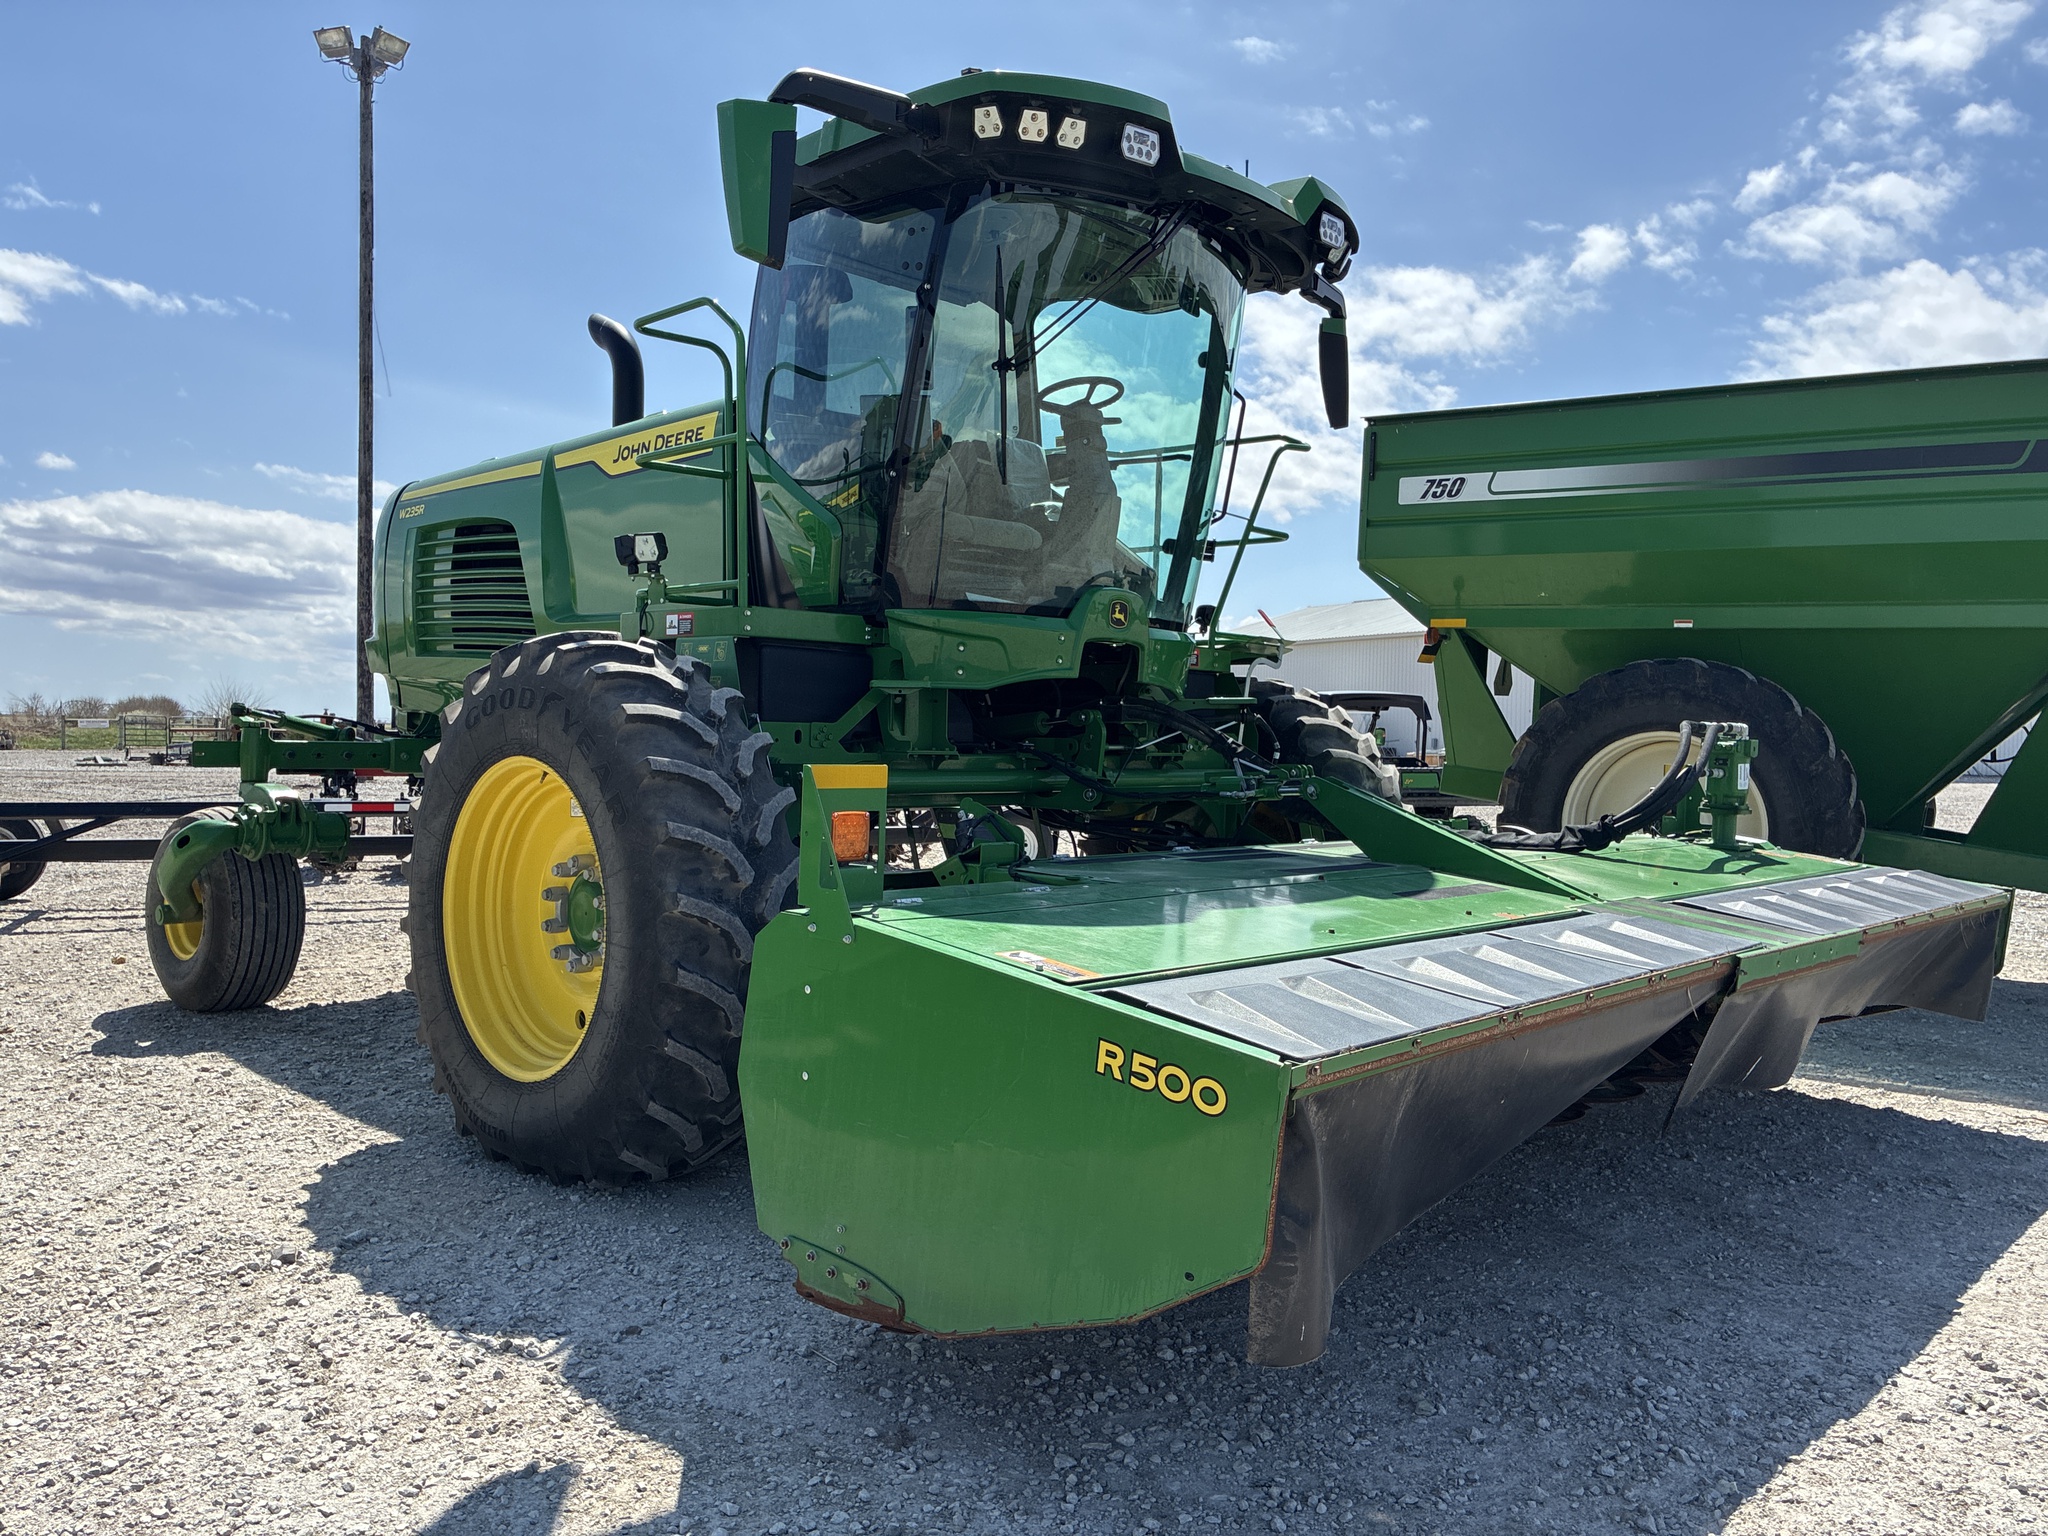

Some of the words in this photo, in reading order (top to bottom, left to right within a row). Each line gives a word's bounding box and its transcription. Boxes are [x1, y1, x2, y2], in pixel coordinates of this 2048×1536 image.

[612, 440, 652, 464] JOHN
[653, 425, 706, 452] DEERE
[1419, 476, 1467, 501] 750
[399, 504, 425, 520] W235R
[464, 686, 628, 833] GOODYEAR
[1095, 1037, 1228, 1117] R500
